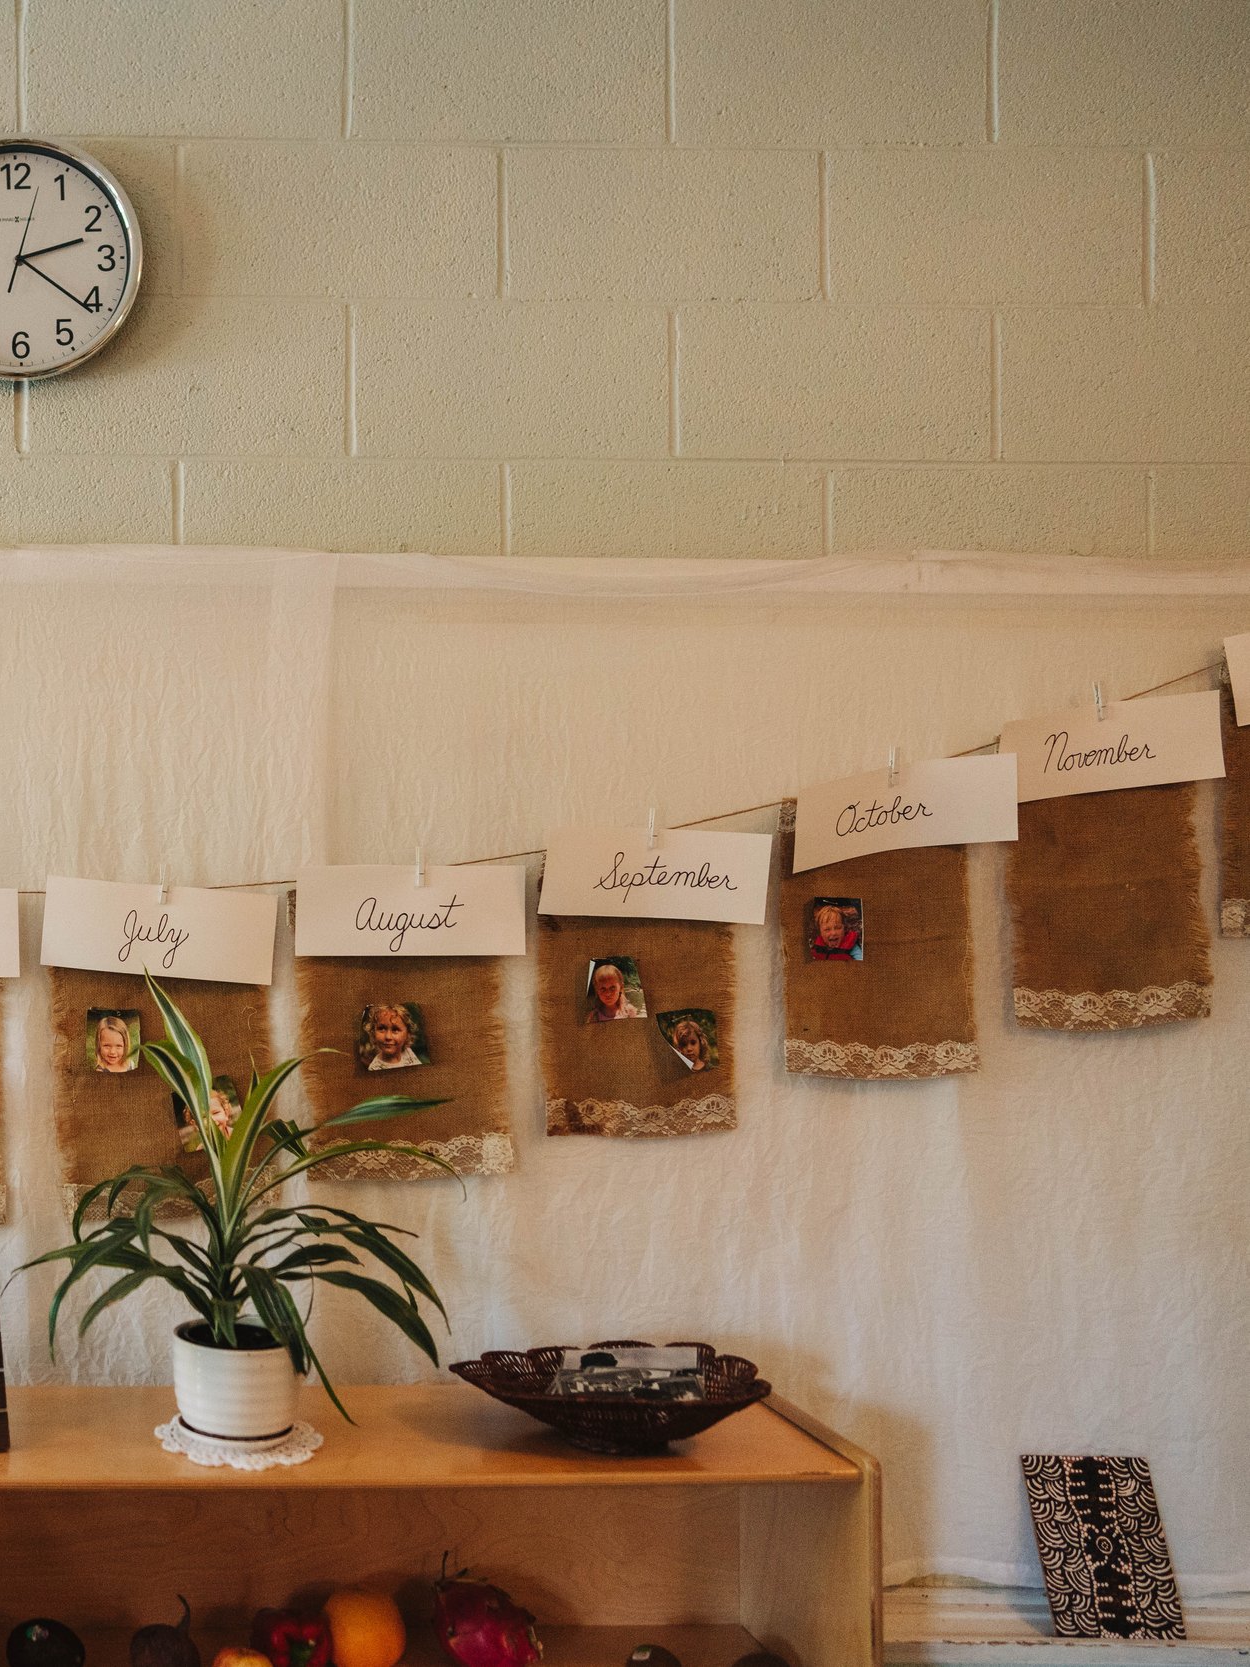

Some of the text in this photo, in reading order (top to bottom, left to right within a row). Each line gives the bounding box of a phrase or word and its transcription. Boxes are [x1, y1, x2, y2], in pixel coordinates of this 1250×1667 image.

[0, 162, 31, 190] 12
[53, 174, 65, 201] 1
[85, 205, 102, 232] 2
[98, 245, 115, 271] 3
[83, 286, 103, 313] 4
[11, 331, 30, 359] 6
[55, 318, 74, 346] 5
[1044, 731, 1156, 773] November
[836, 796, 933, 837] October
[593, 852, 738, 903] September
[355, 894, 464, 952] August
[118, 910, 190, 969] July
